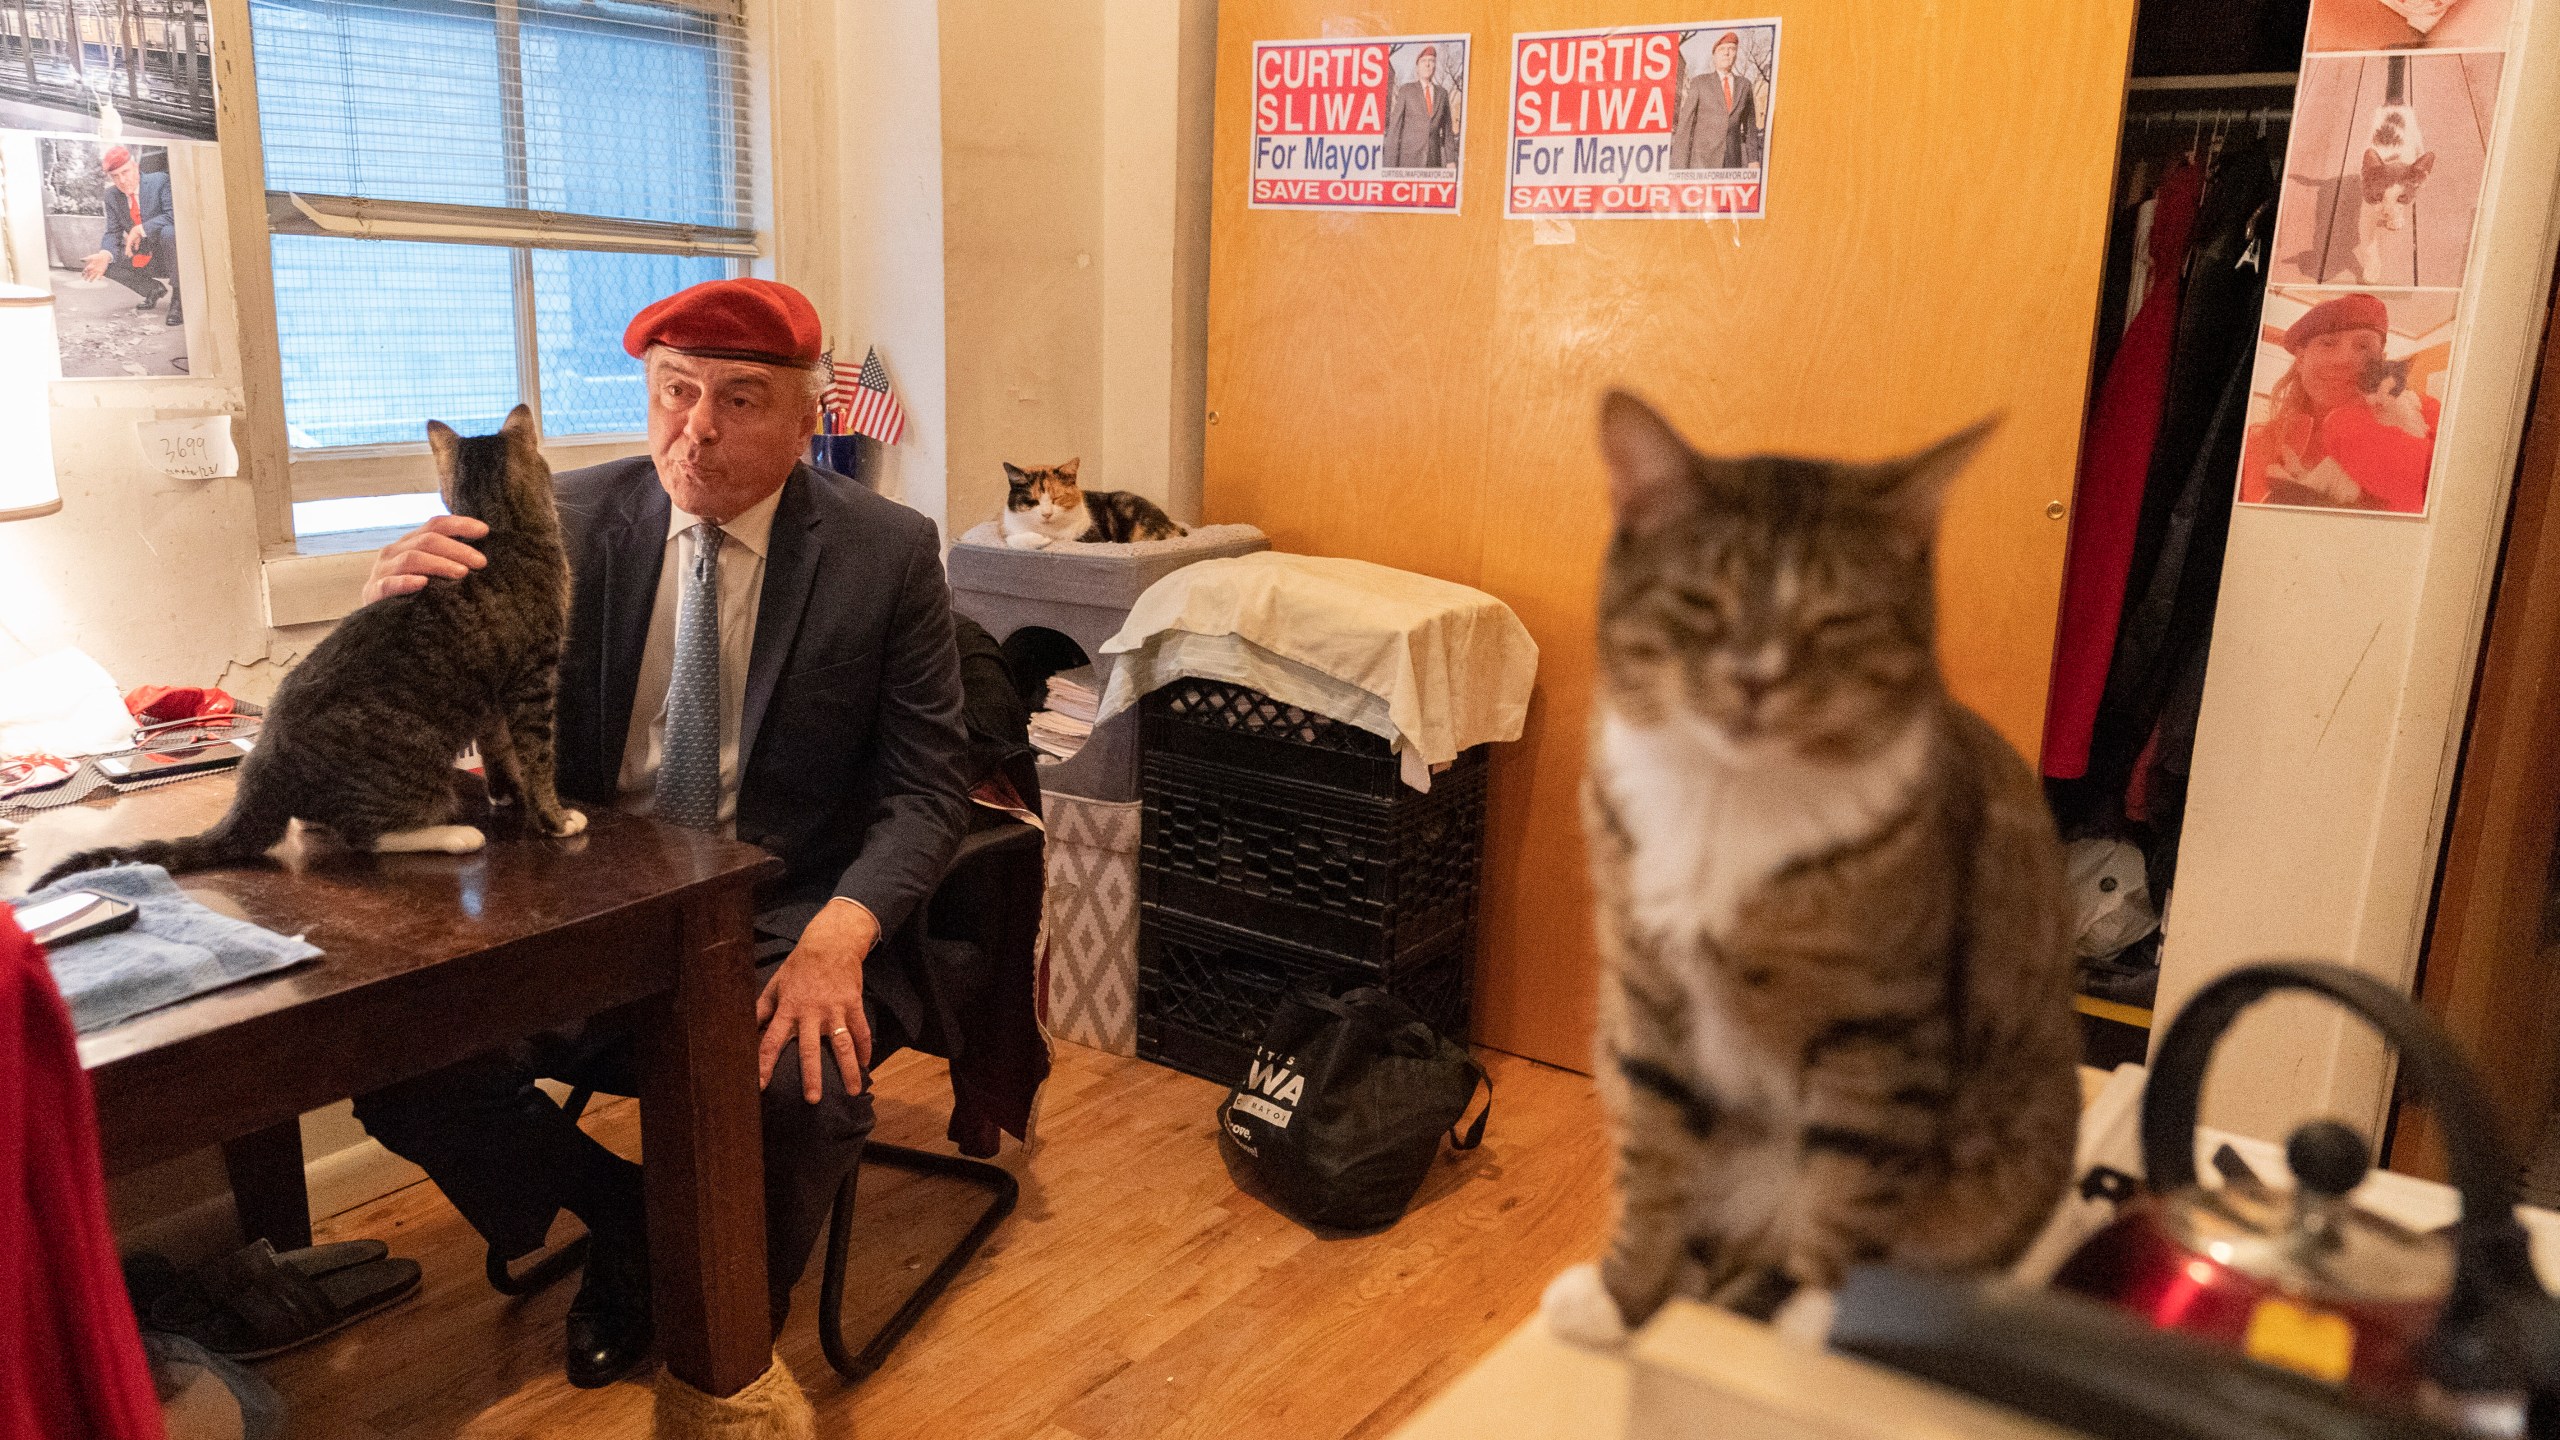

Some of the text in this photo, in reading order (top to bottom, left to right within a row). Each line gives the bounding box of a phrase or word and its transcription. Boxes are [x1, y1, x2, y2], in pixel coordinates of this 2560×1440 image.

[1258, 46, 1384, 89] CURTIS
[1520, 35, 1672, 86] CURTIS
[1258, 93, 1381, 132] SLIWA
[1517, 86, 1668, 133] SLIWA
[1257, 137, 1381, 179] For Mayor
[1515, 137, 1668, 183] For Mayor
[1255, 181, 1454, 203] SAVE OUR CITY
[1513, 185, 1757, 208] SAVE OUR CITY
[160, 437, 208, 463] 3699
